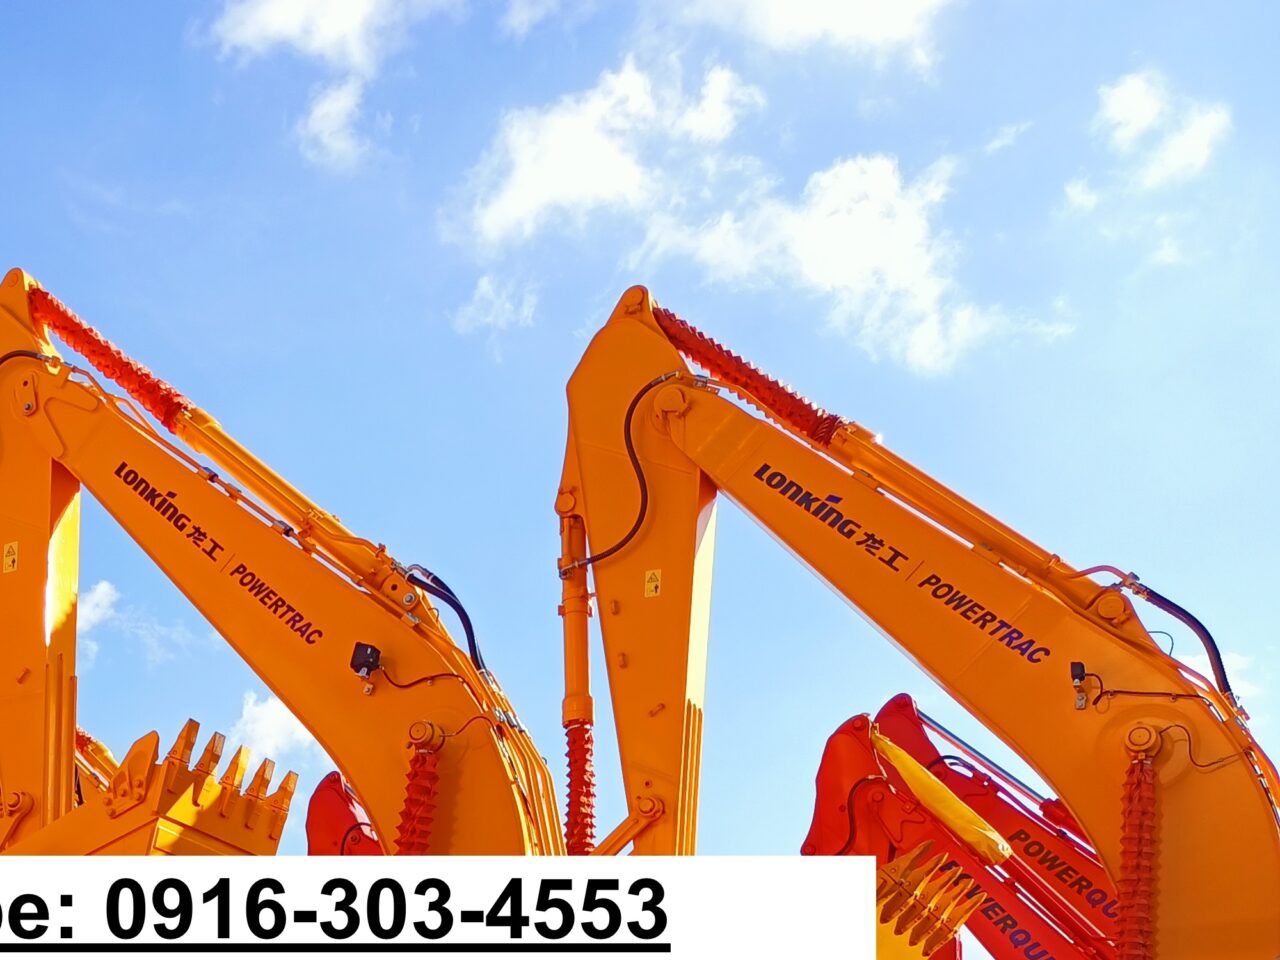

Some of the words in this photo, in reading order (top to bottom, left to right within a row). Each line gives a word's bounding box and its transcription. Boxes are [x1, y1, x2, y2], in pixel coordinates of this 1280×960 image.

[229, 564, 324, 645] POWERTRAC
[918, 574, 1051, 664] POWERTRAC
[1008, 829, 1119, 919] POWERQU
